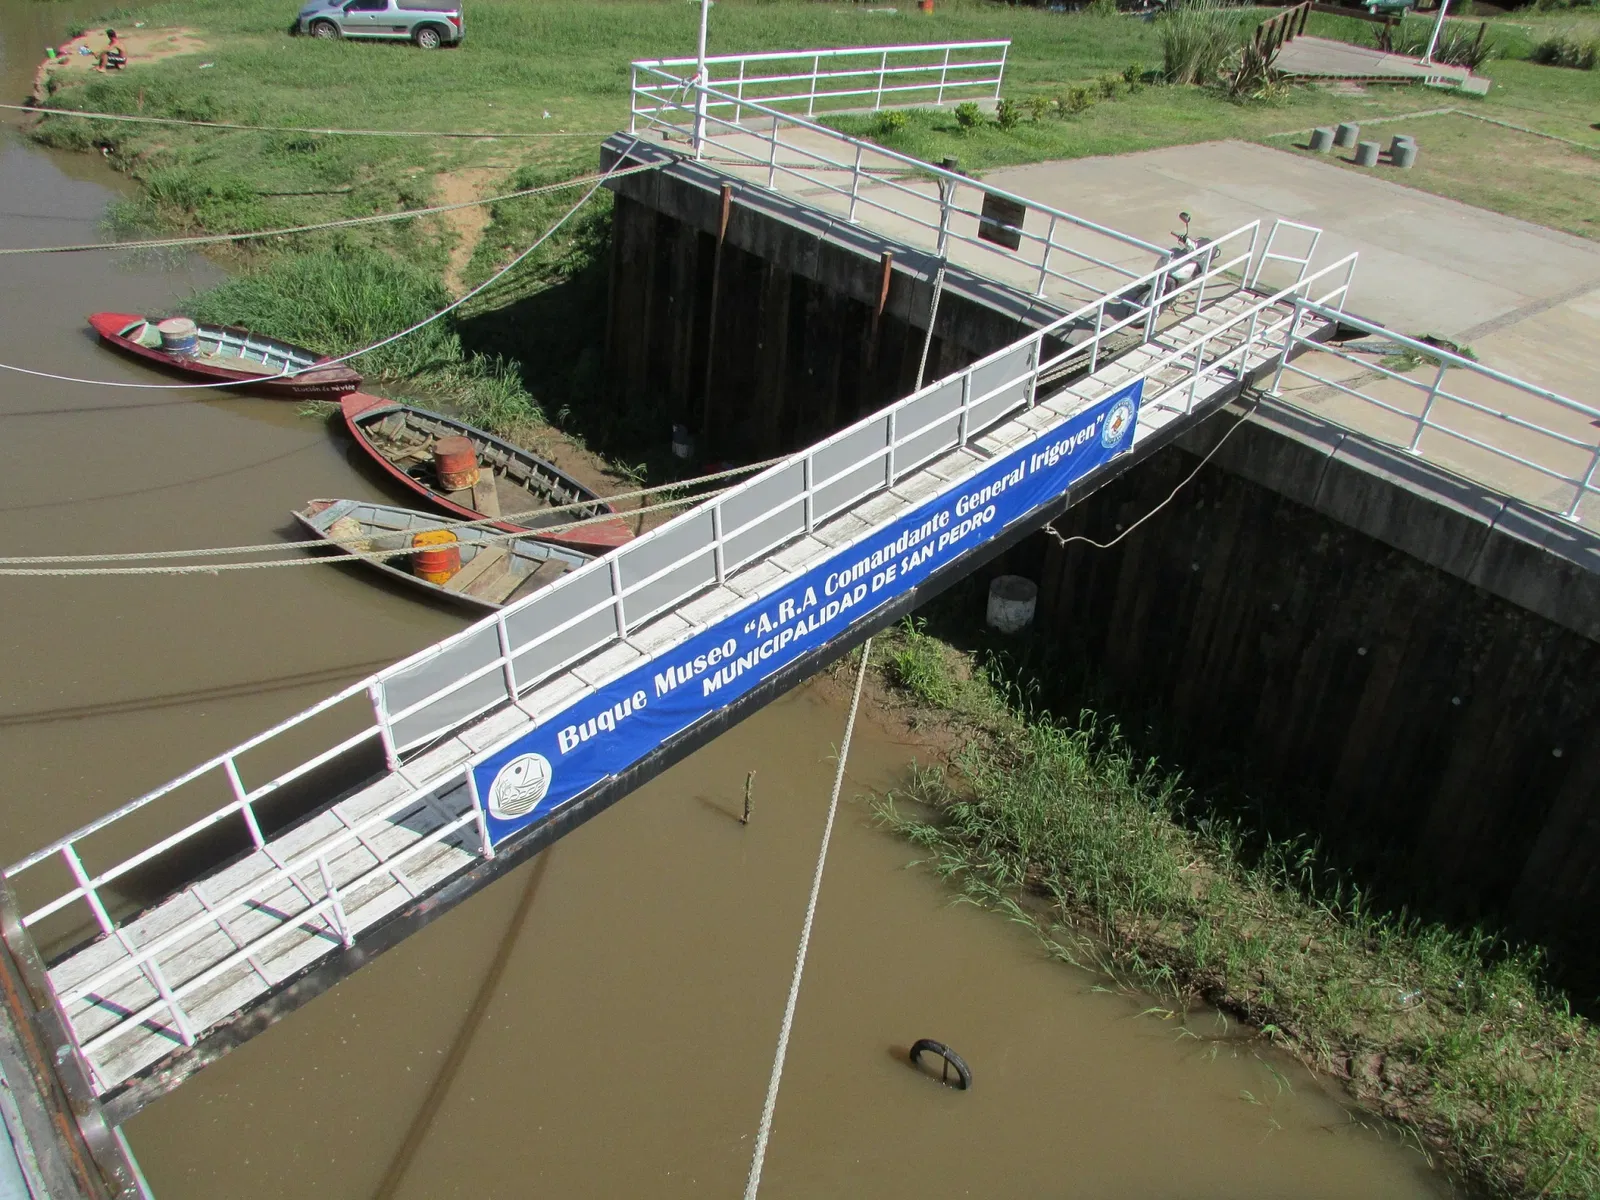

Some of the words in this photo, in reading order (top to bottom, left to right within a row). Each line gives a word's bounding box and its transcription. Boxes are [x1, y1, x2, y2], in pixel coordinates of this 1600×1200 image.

[557, 690, 647, 755] Buque
[654, 638, 737, 697] Museo
[824, 510, 950, 596] Comandante
[956, 460, 1025, 516] General
[703, 583, 867, 697] MUNICIPALIDAD
[872, 564, 897, 592] DE
[901, 541, 934, 575] SAN
[938, 504, 996, 551] PEDRO
